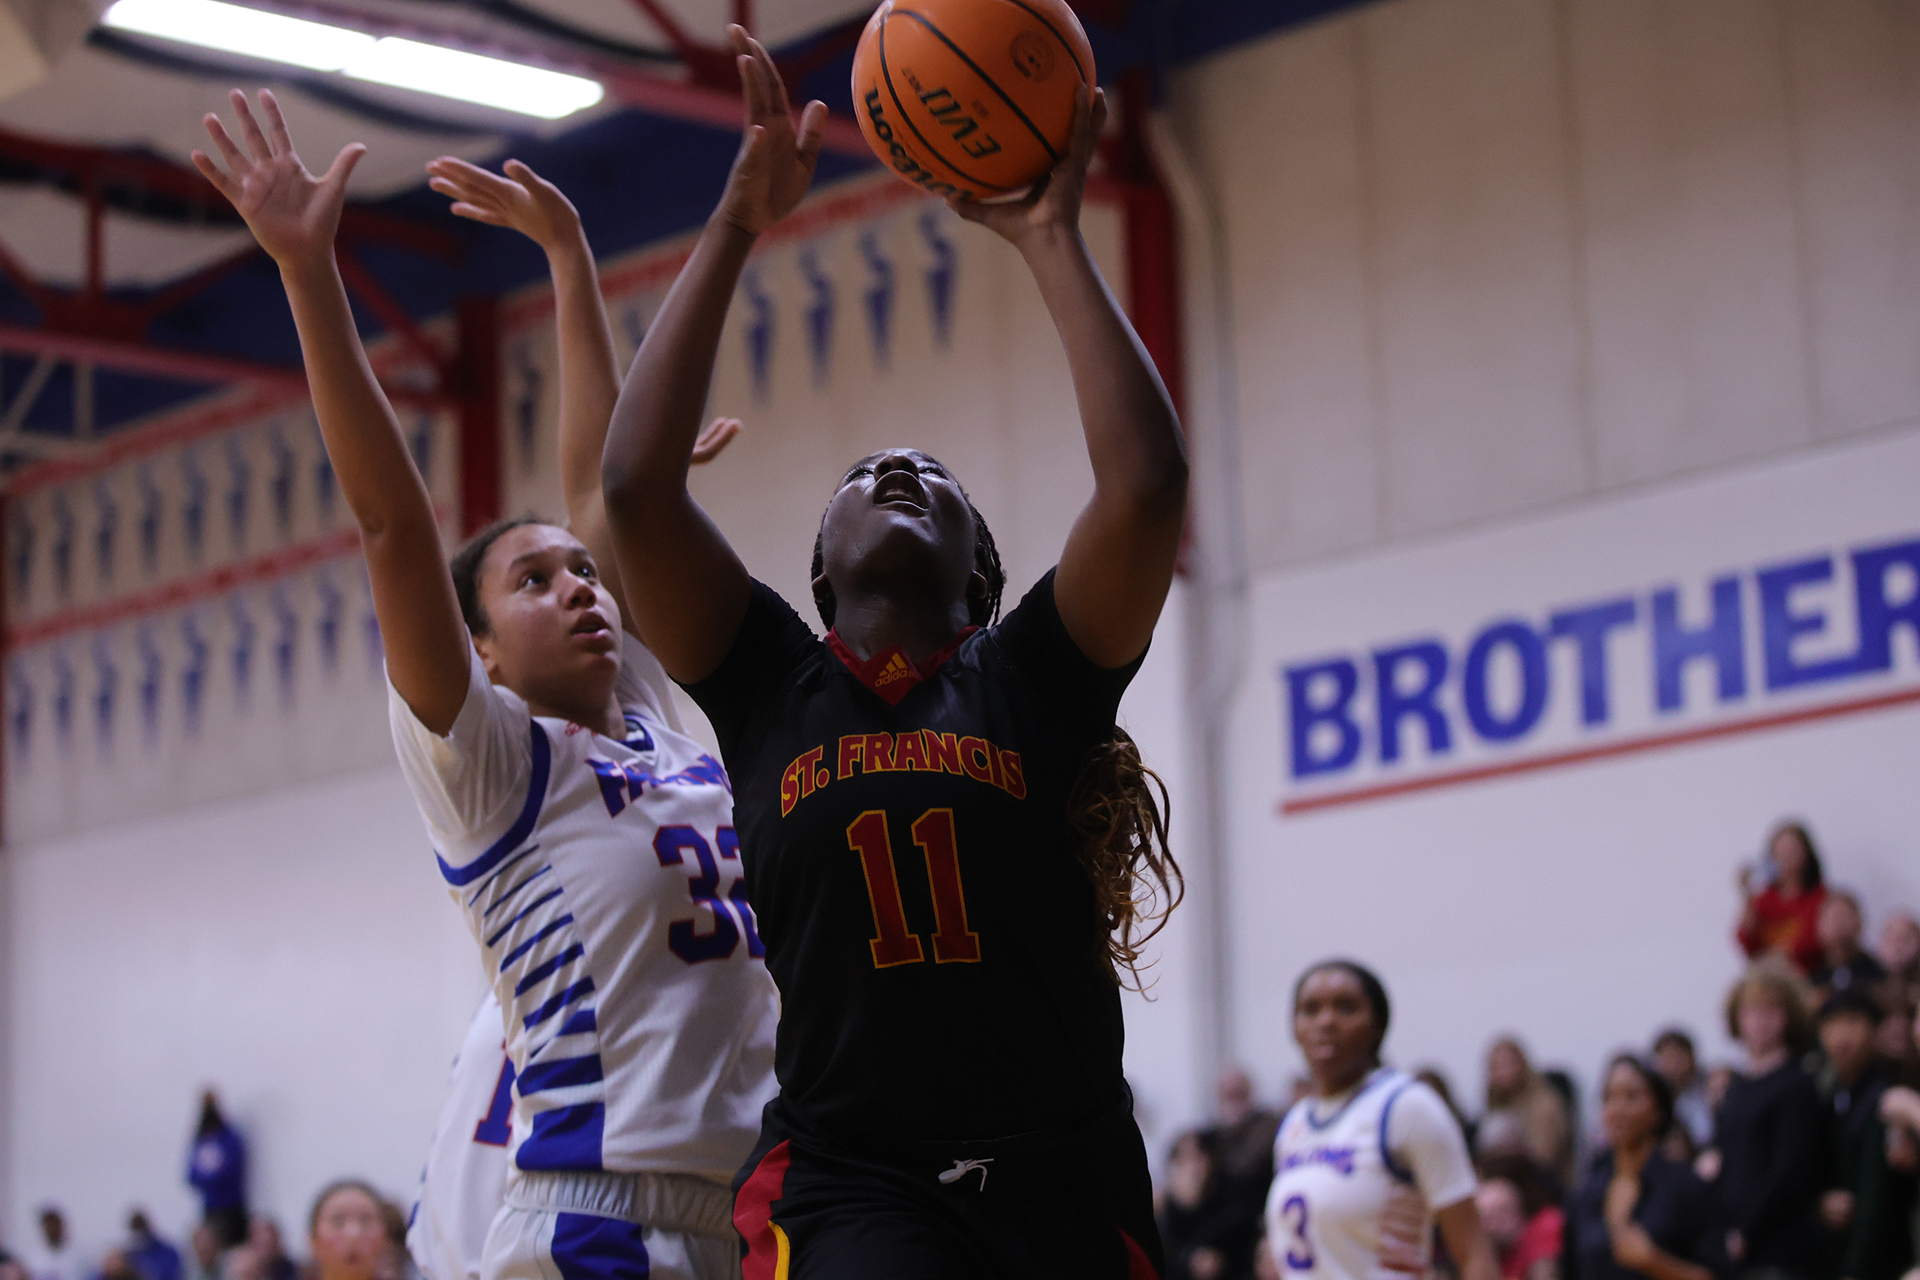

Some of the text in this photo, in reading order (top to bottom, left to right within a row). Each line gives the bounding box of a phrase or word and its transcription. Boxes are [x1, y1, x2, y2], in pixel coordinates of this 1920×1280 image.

[875, 668, 915, 688] adidas
[1284, 537, 1920, 781] BROTHER
[780, 744, 830, 818] ST.
[836, 728, 1027, 800] FRANCIS
[845, 807, 982, 969] 11
[1283, 1193, 1316, 1271] 3
